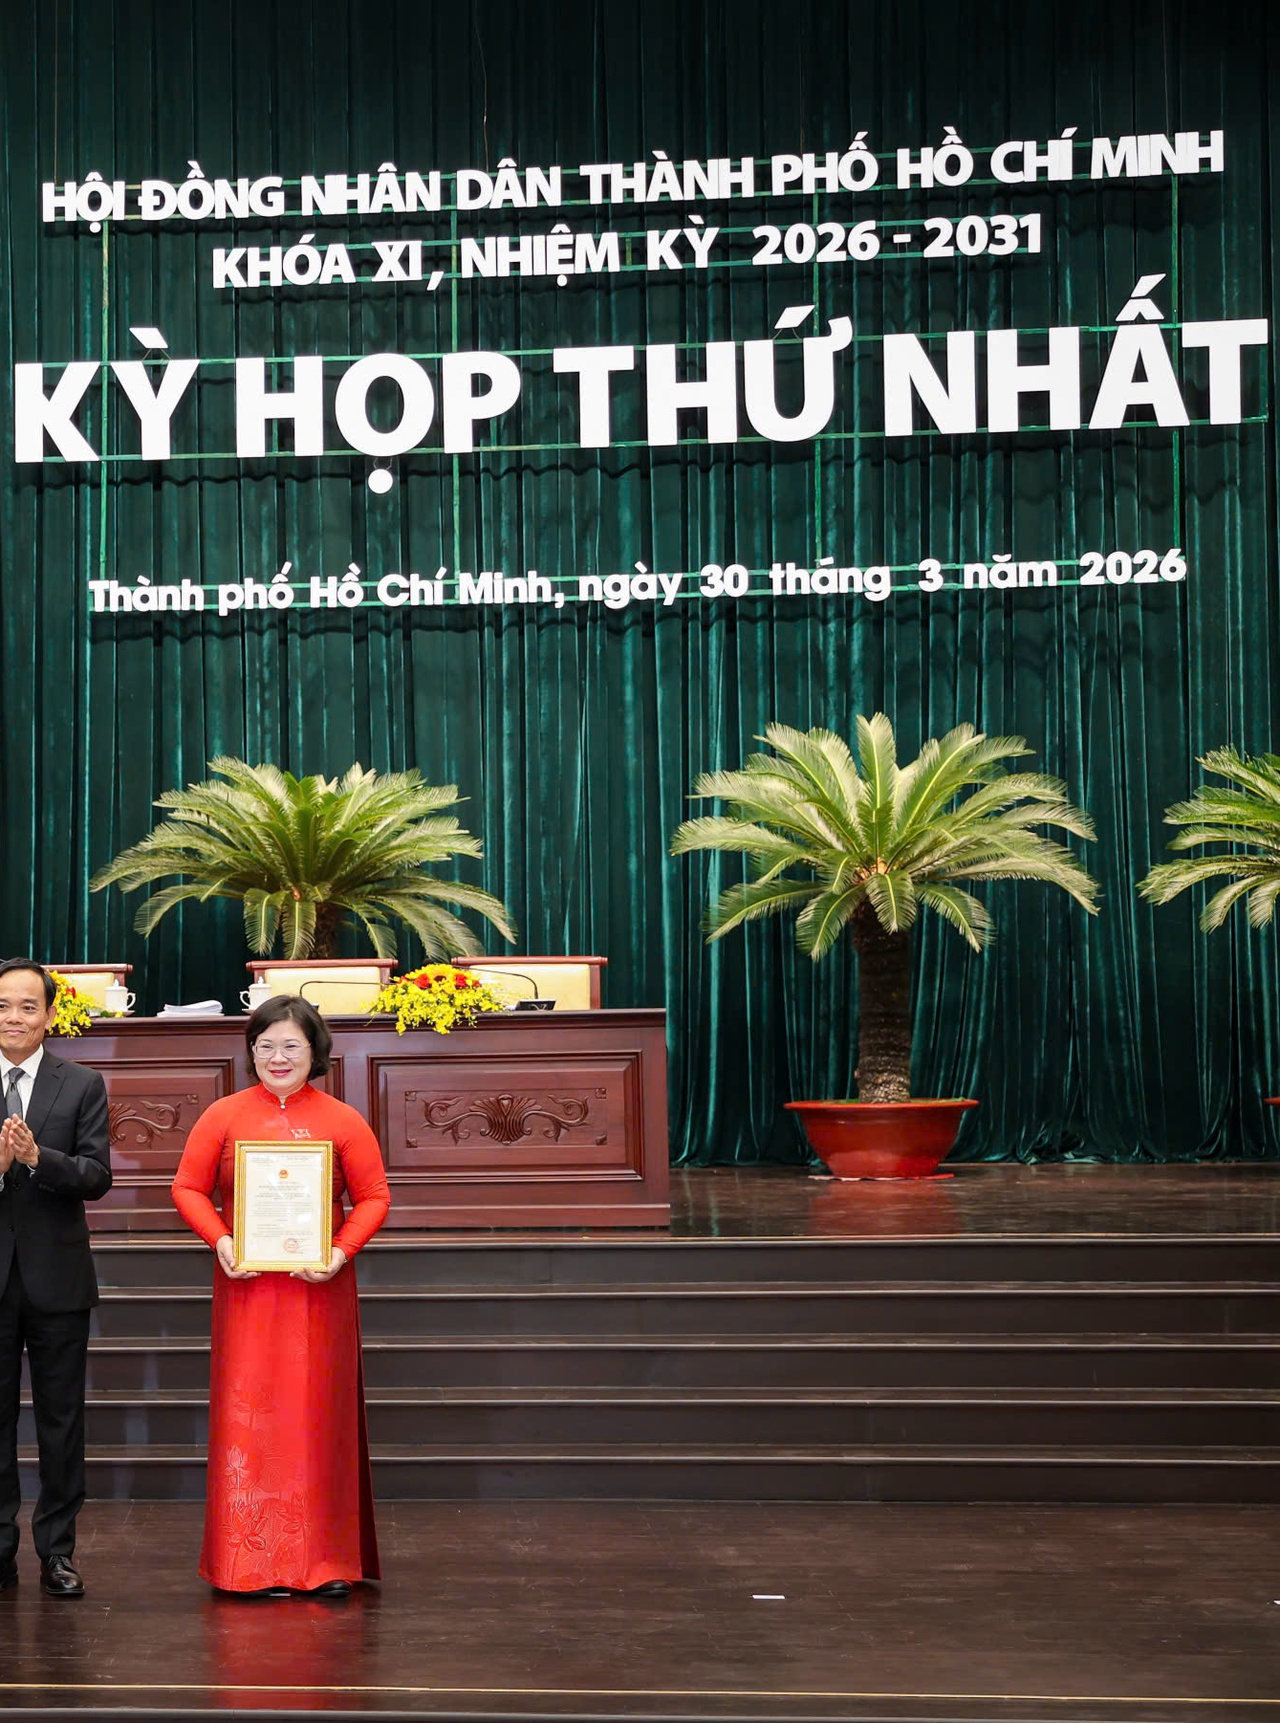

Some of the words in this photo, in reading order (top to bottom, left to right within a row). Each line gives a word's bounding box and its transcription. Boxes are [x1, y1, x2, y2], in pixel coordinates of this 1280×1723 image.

[42, 172, 125, 233] HỘI
[138, 161, 285, 222] ĐỒNG
[301, 163, 442, 216] NHÂN
[457, 158, 562, 210] DÂN
[579, 150, 755, 204] THÀNH
[772, 131, 879, 195] PHỐ
[897, 126, 974, 189] HỒ
[990, 127, 1077, 183] CHÍ
[1091, 130, 1224, 179] MINH
[213, 234, 357, 289] KHÓA
[371, 239, 445, 291] XI,
[461, 224, 621, 287] NHIỆM
[647, 215, 720, 271] KỲ
[752, 221, 880, 265] 2026
[892, 233, 912, 244] -
[923, 213, 1042, 257] 2031
[15, 328, 202, 464] KỲ
[236, 351, 521, 494] HỌP
[553, 305, 853, 449] THỨ
[884, 273, 1269, 437] NHẤT
[88, 574, 206, 613] Thành
[218, 562, 295, 617] phố
[310, 563, 364, 608] Hồ
[377, 566, 448, 607] Chí
[455, 570, 567, 609] Minh,
[578, 560, 684, 610] ngày
[699, 564, 749, 598] 30
[769, 556, 893, 602] tháng
[917, 559, 944, 592] 3
[963, 553, 1059, 590] năm
[1079, 549, 1187, 586] 2026
